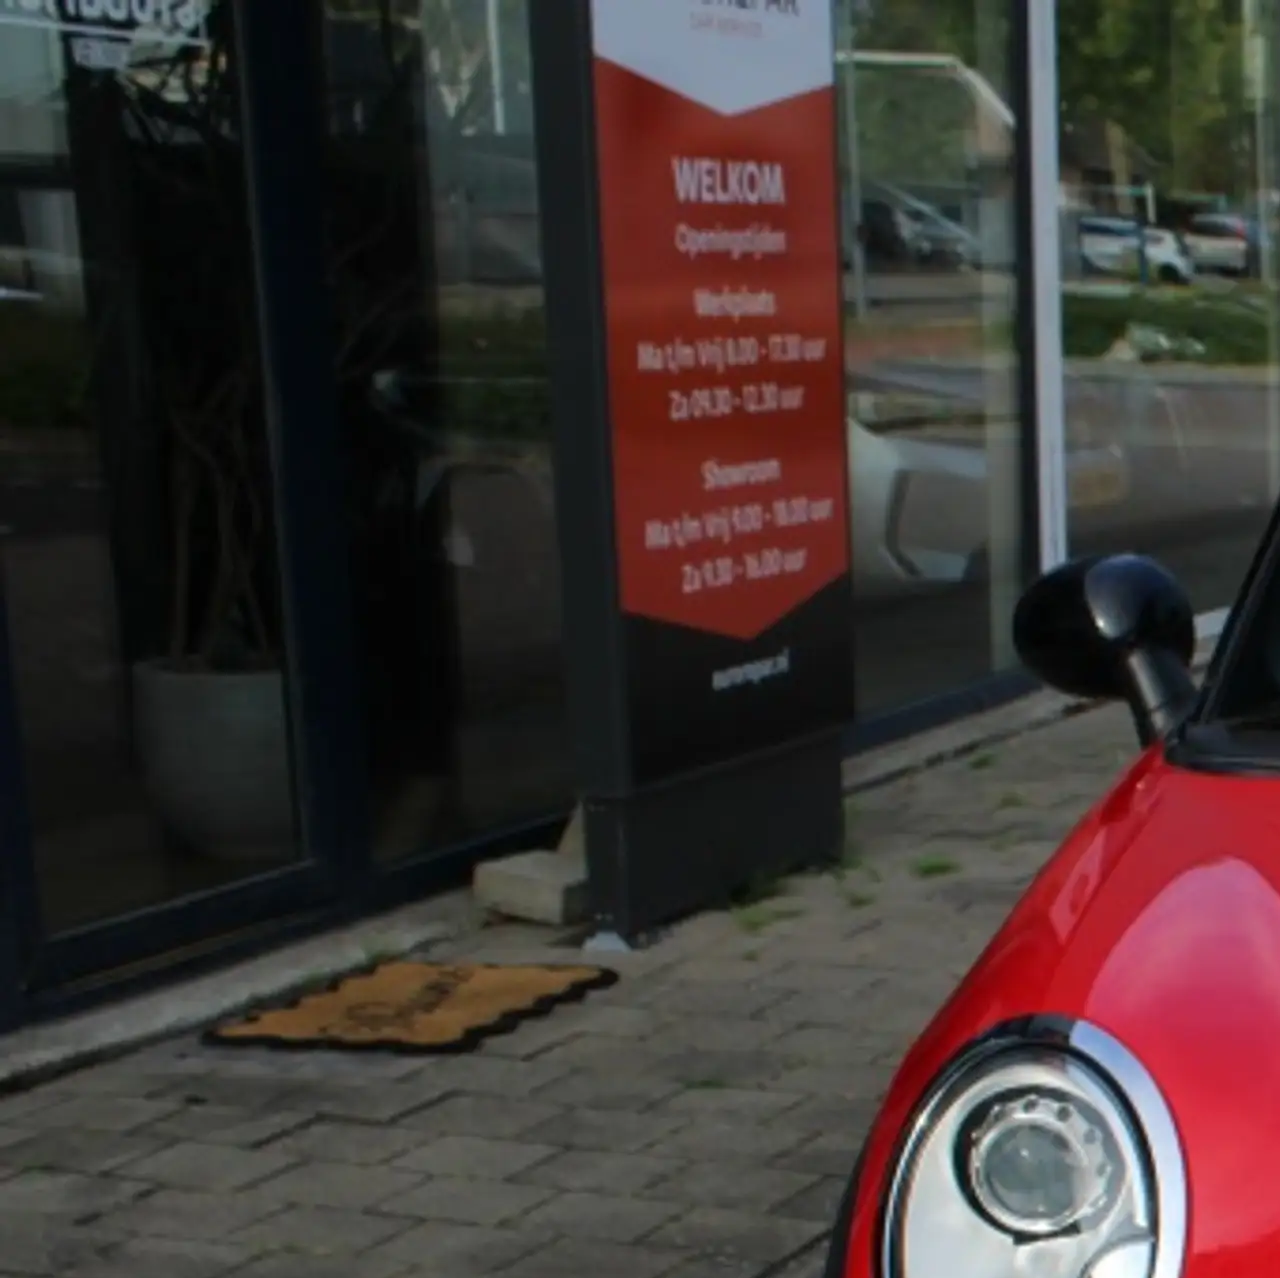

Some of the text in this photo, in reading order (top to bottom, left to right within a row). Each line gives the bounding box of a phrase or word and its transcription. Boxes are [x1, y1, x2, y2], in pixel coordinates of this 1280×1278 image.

[671, 157, 785, 204] WELKOM
[674, 221, 787, 260] Openingstijden
[701, 455, 781, 491] Showroom
